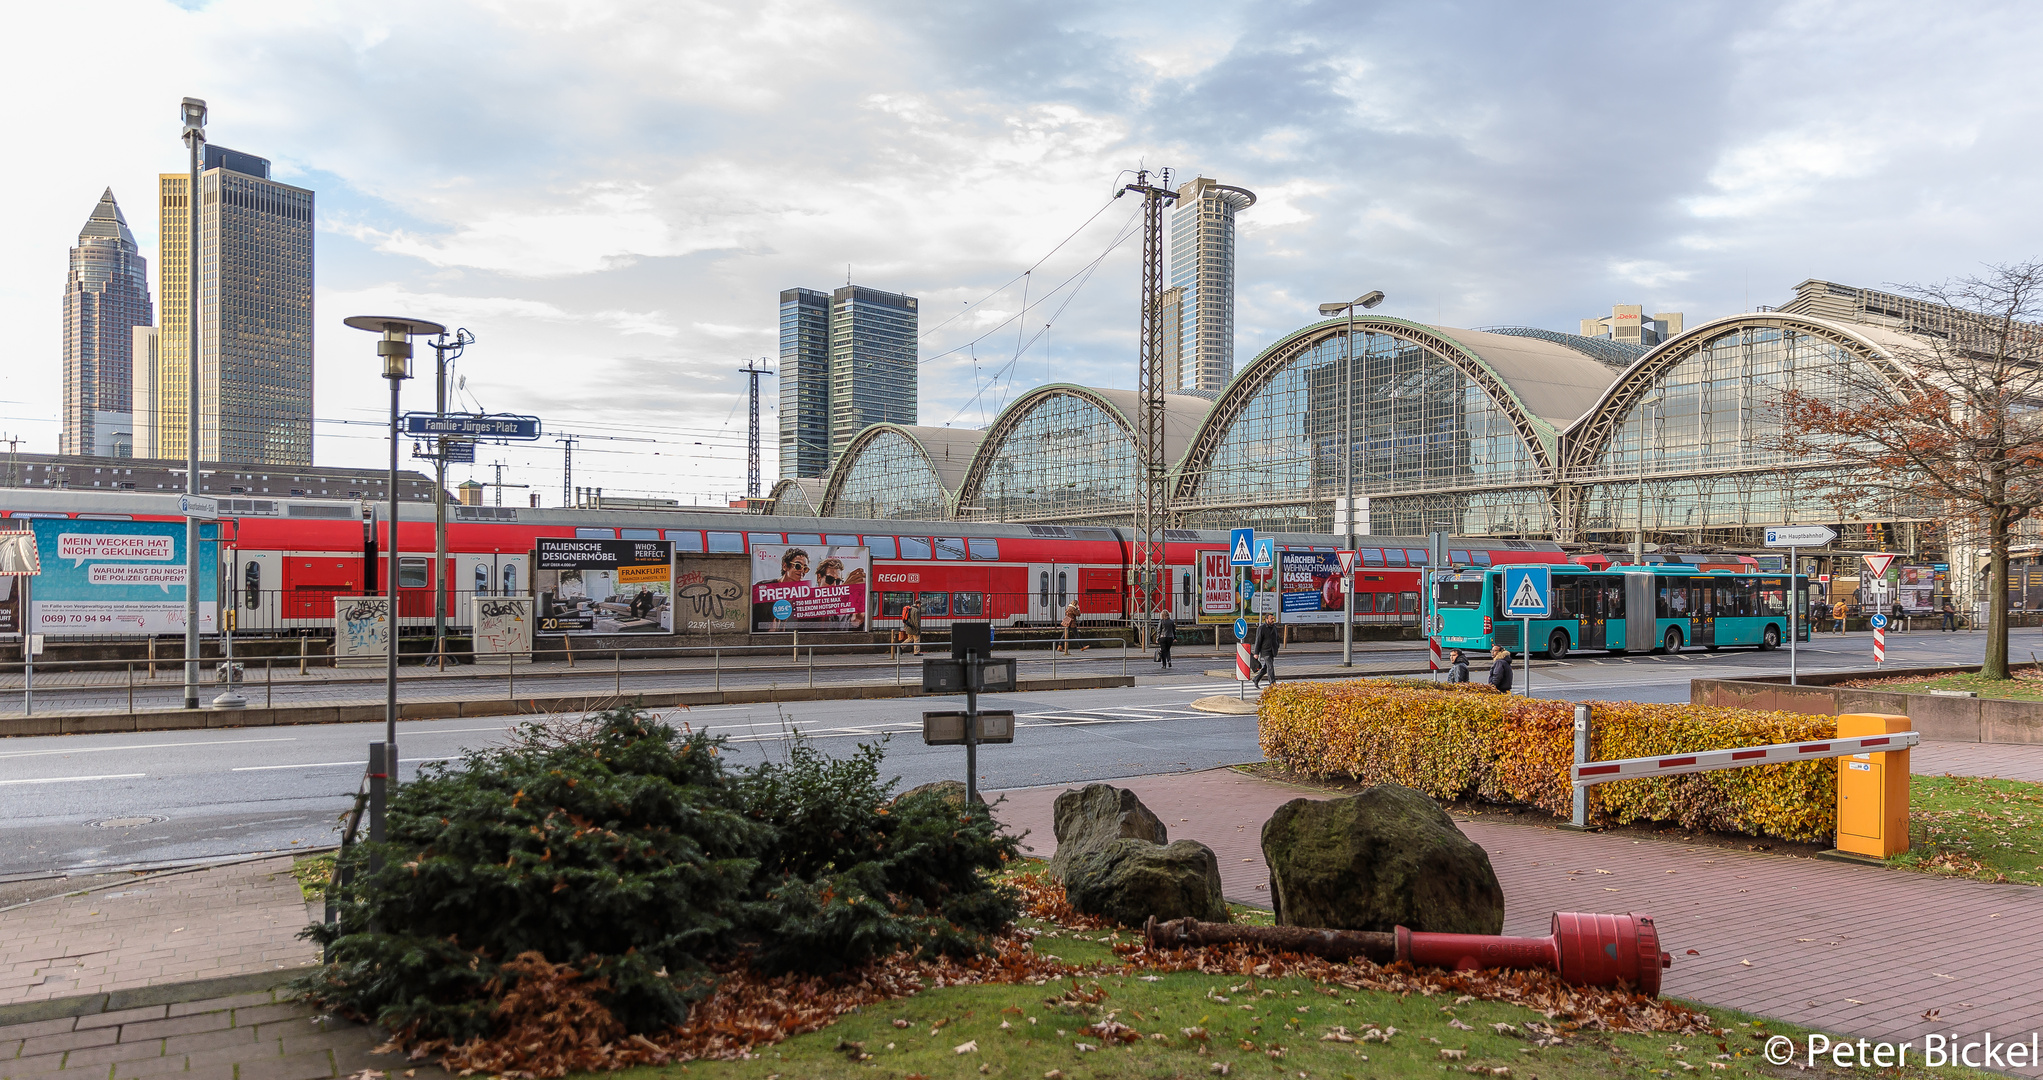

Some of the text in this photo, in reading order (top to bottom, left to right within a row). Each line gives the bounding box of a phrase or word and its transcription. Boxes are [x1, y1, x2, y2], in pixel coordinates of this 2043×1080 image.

[426, 420, 518, 433] Familie-Jürges-Platz
[542, 543, 602, 551] ITALIENISCHE
[102, 548, 169, 556] GEKLINGELT
[542, 552, 617, 561] DESIGNERMÖBEL
[1284, 554, 1315, 564] MÄRCHEN
[1206, 556, 1231, 577] NEU
[878, 574, 907, 582] REGIO
[1284, 572, 1313, 582] KASSEL
[1206, 579, 1217, 590] AN
[1219, 579, 1231, 590] DER
[724, 588, 737, 597] 12
[759, 586, 850, 601] PREPAID DELUXE
[1206, 592, 1231, 601] HANAUER
[987, 594, 991, 602] 2
[42, 615, 66, 623] (069)
[542, 618, 557, 629] 20
